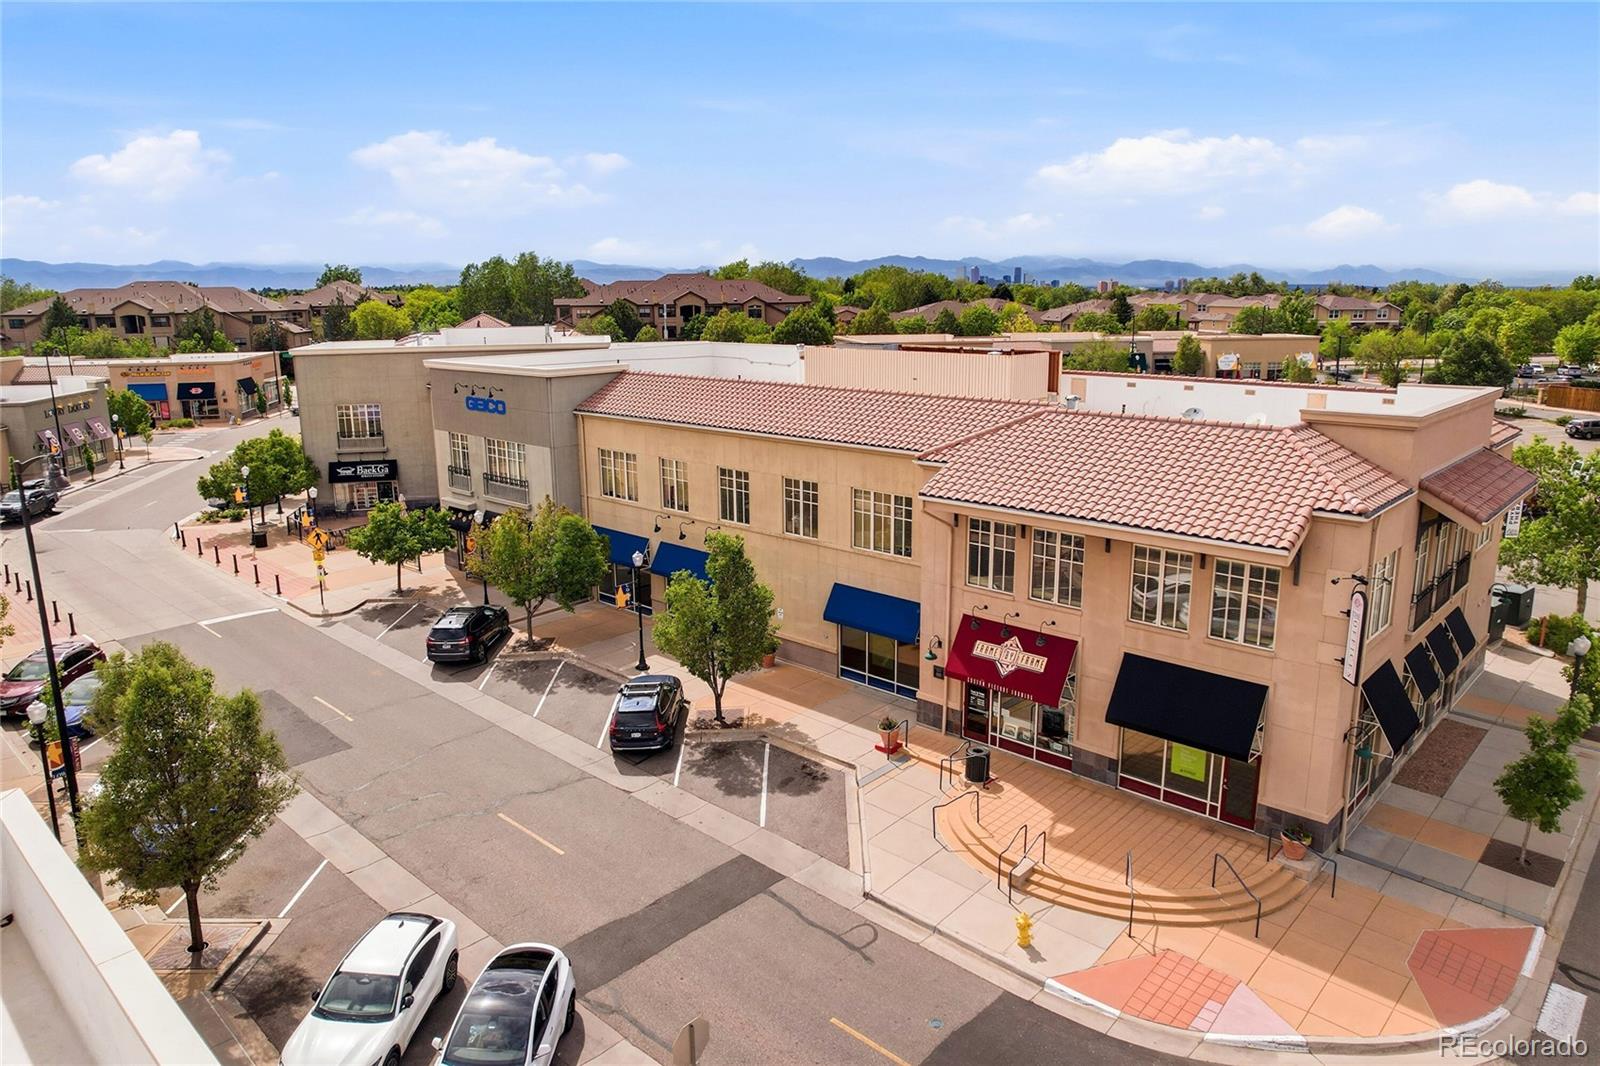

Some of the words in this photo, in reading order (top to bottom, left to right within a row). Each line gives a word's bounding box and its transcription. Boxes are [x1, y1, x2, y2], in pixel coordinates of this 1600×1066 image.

[465, 396, 506, 415] GEICO
[977, 643, 998, 656] FRAME
[1021, 655, 1044, 668] FRAME
